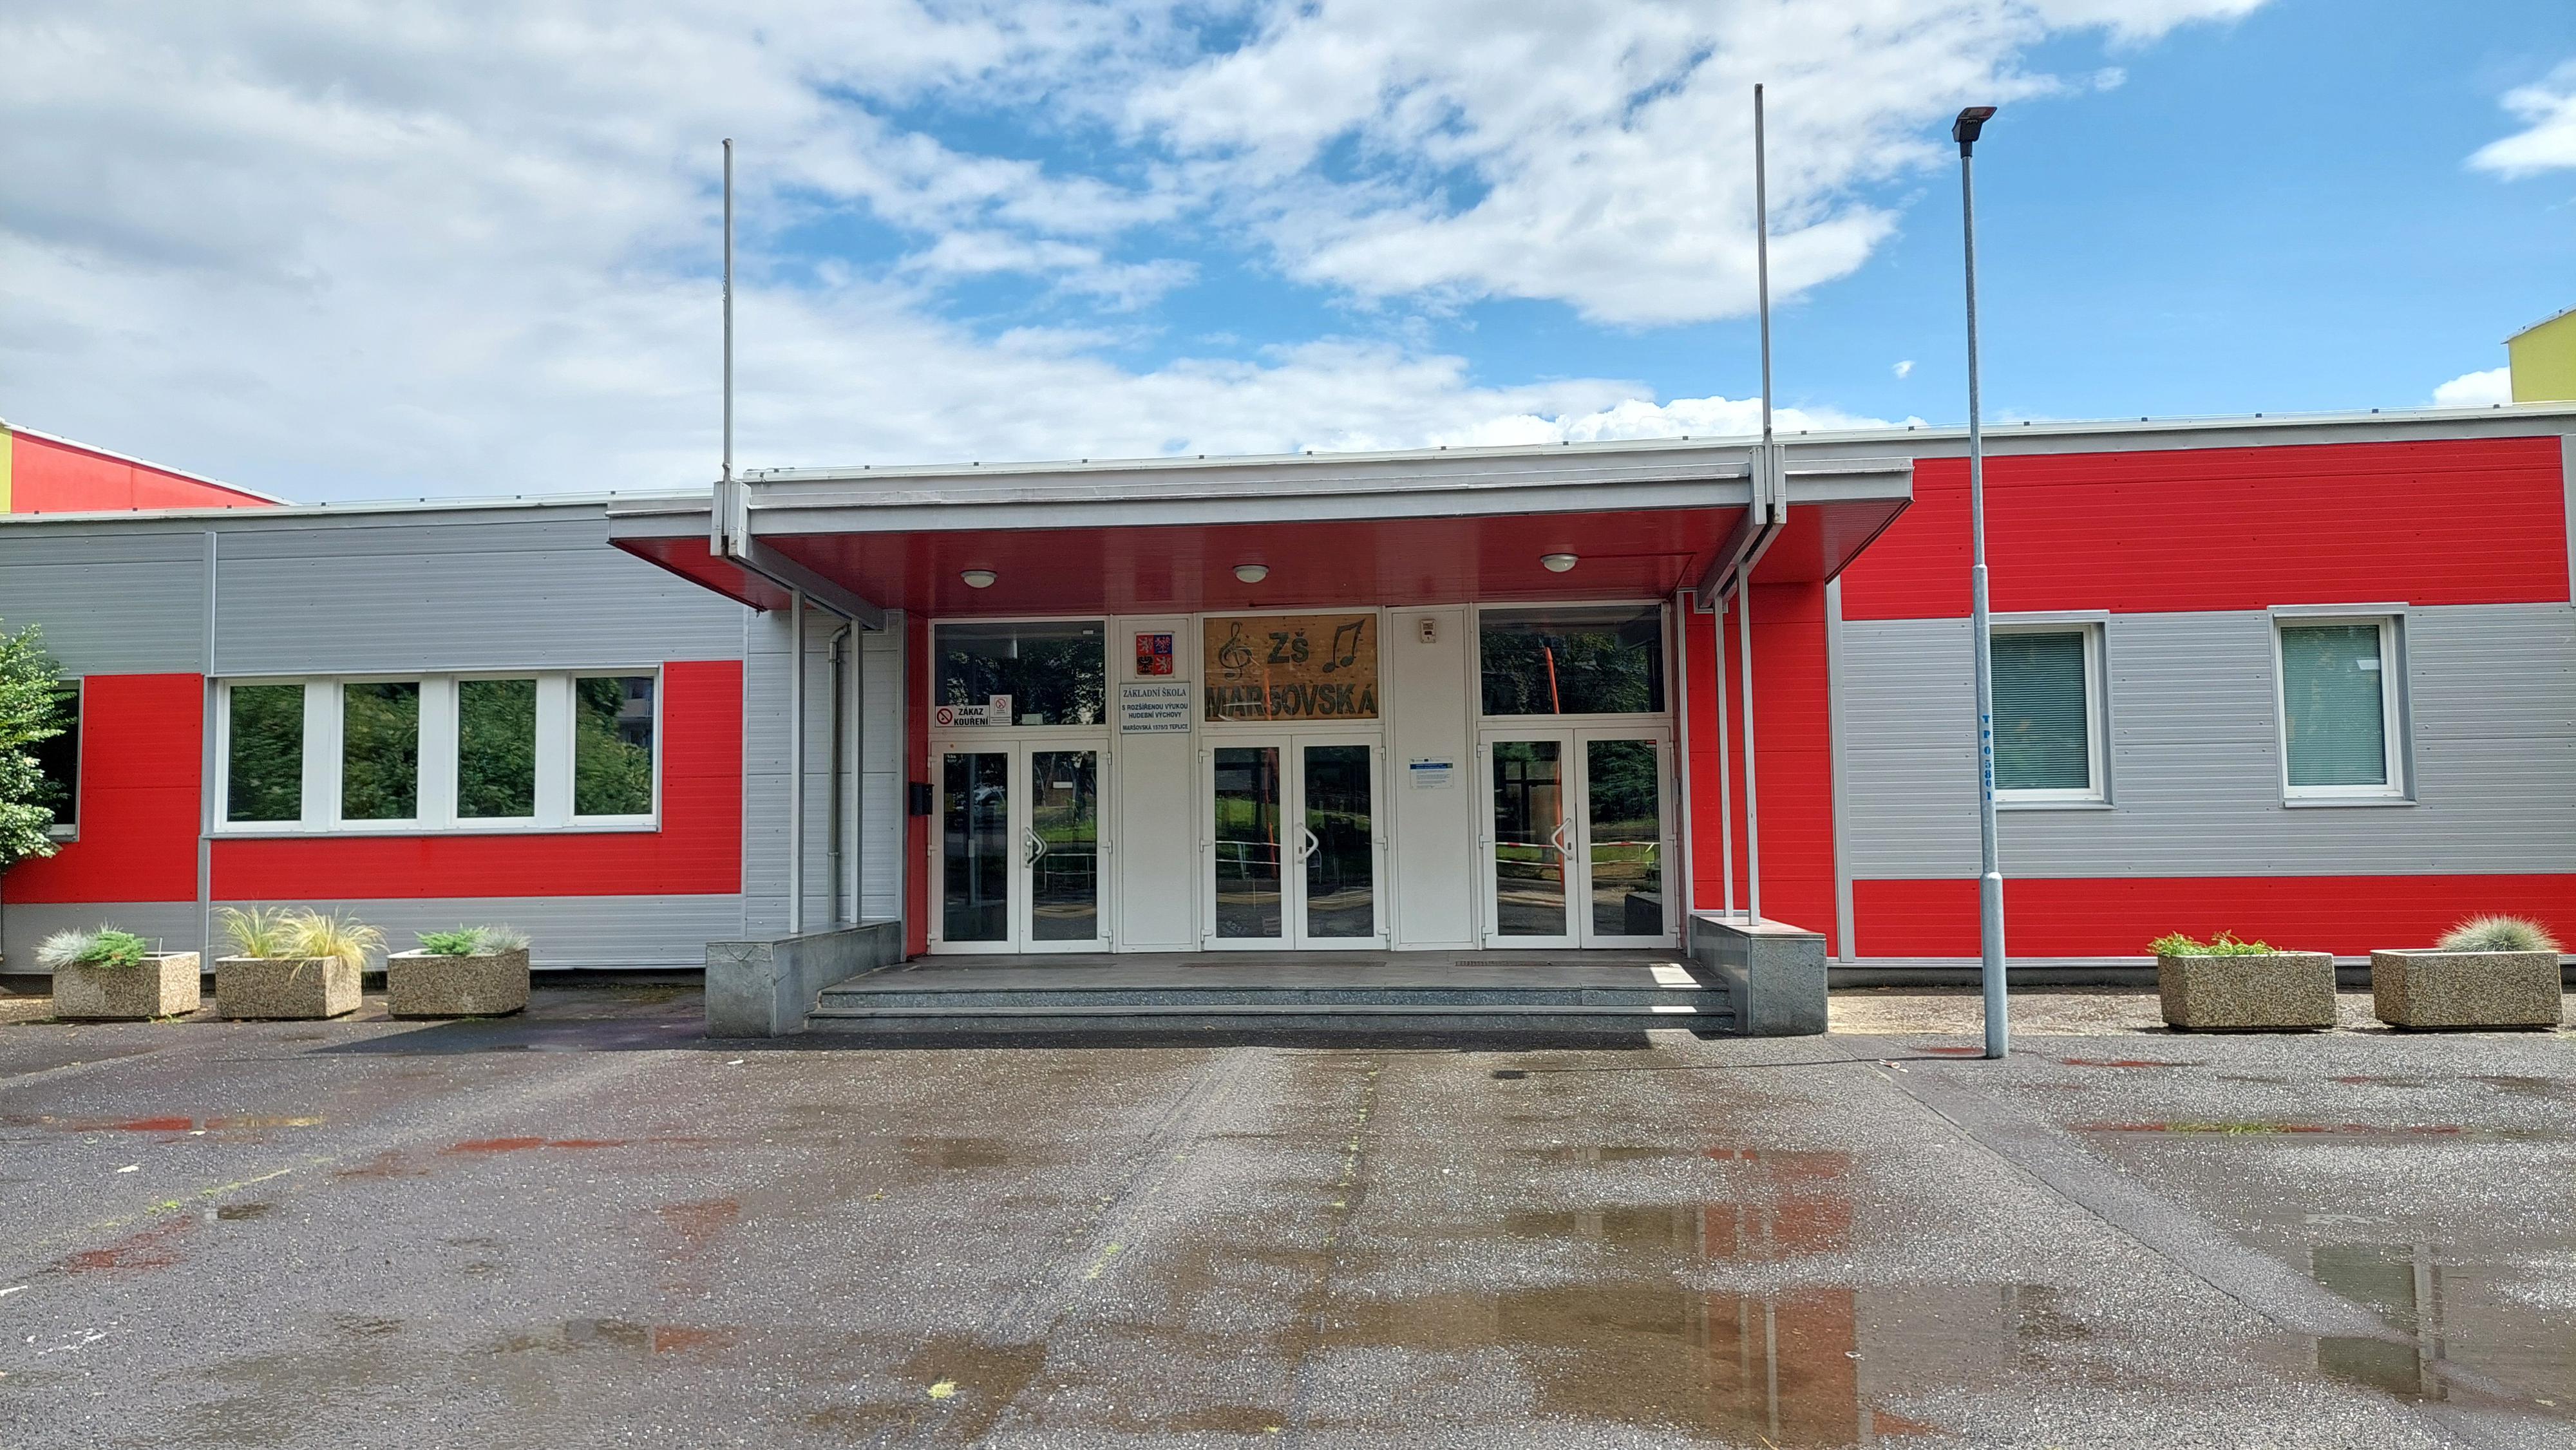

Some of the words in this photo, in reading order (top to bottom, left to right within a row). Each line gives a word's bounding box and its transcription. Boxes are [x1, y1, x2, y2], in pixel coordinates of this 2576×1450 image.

[1267, 628, 1309, 664] ZŠ
[1123, 686, 1160, 697] ZÁKLADNÍ
[1162, 687, 1186, 697] ŠKOLA
[958, 706, 983, 715] ZÁKAZ
[954, 716, 989, 726] KOUŘENÍ
